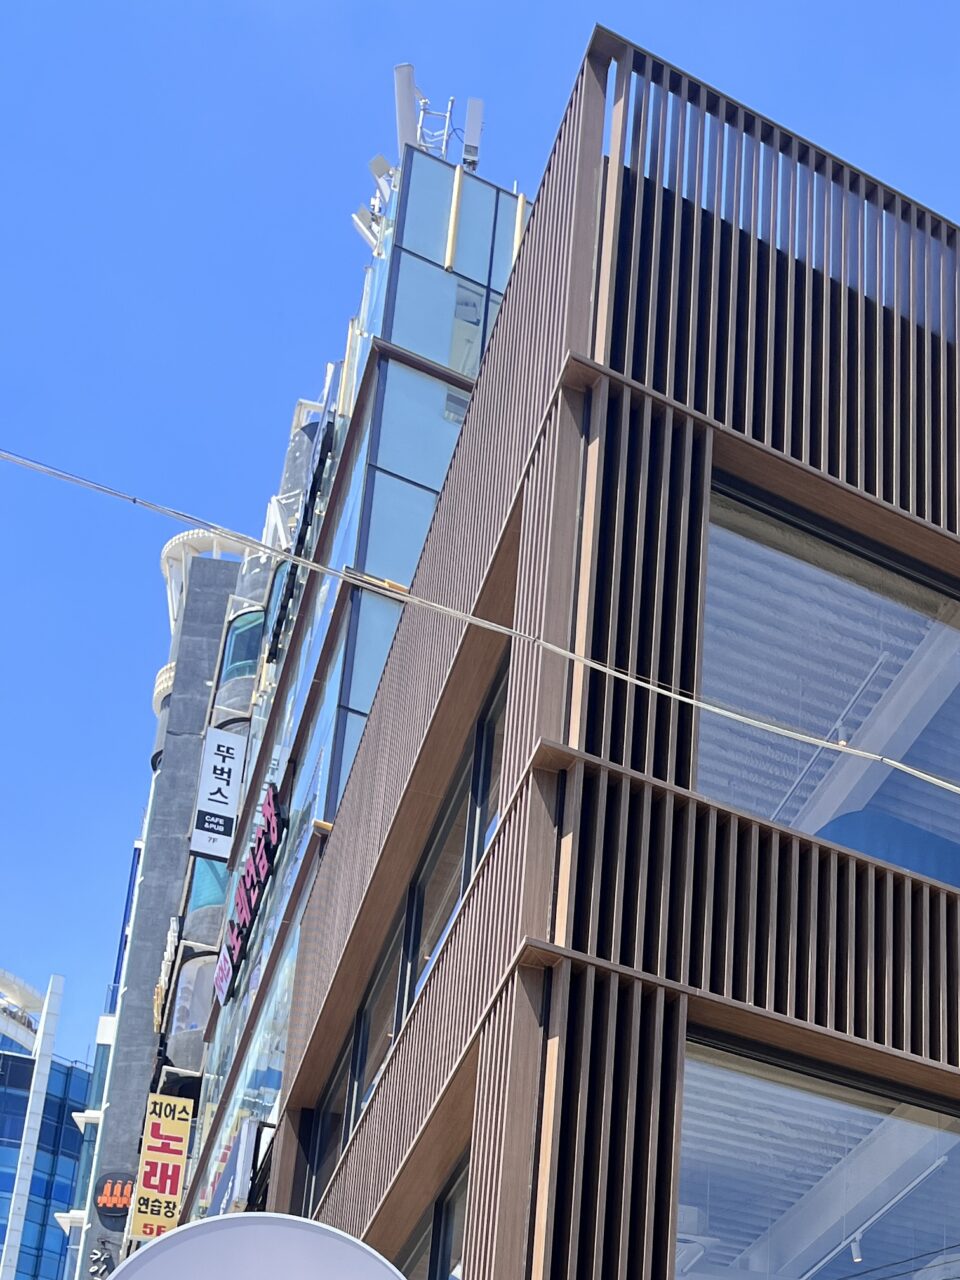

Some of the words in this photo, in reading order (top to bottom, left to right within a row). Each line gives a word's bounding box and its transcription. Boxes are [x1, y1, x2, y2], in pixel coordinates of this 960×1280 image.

[207, 743, 236, 805] 뚜벅스
[204, 822, 225, 832] &PUB
[205, 815, 225, 825] CAFE
[149, 1101, 191, 1122] 치어스
[142, 1122, 184, 1196] 노래
[137, 1196, 178, 1218] 연습장
